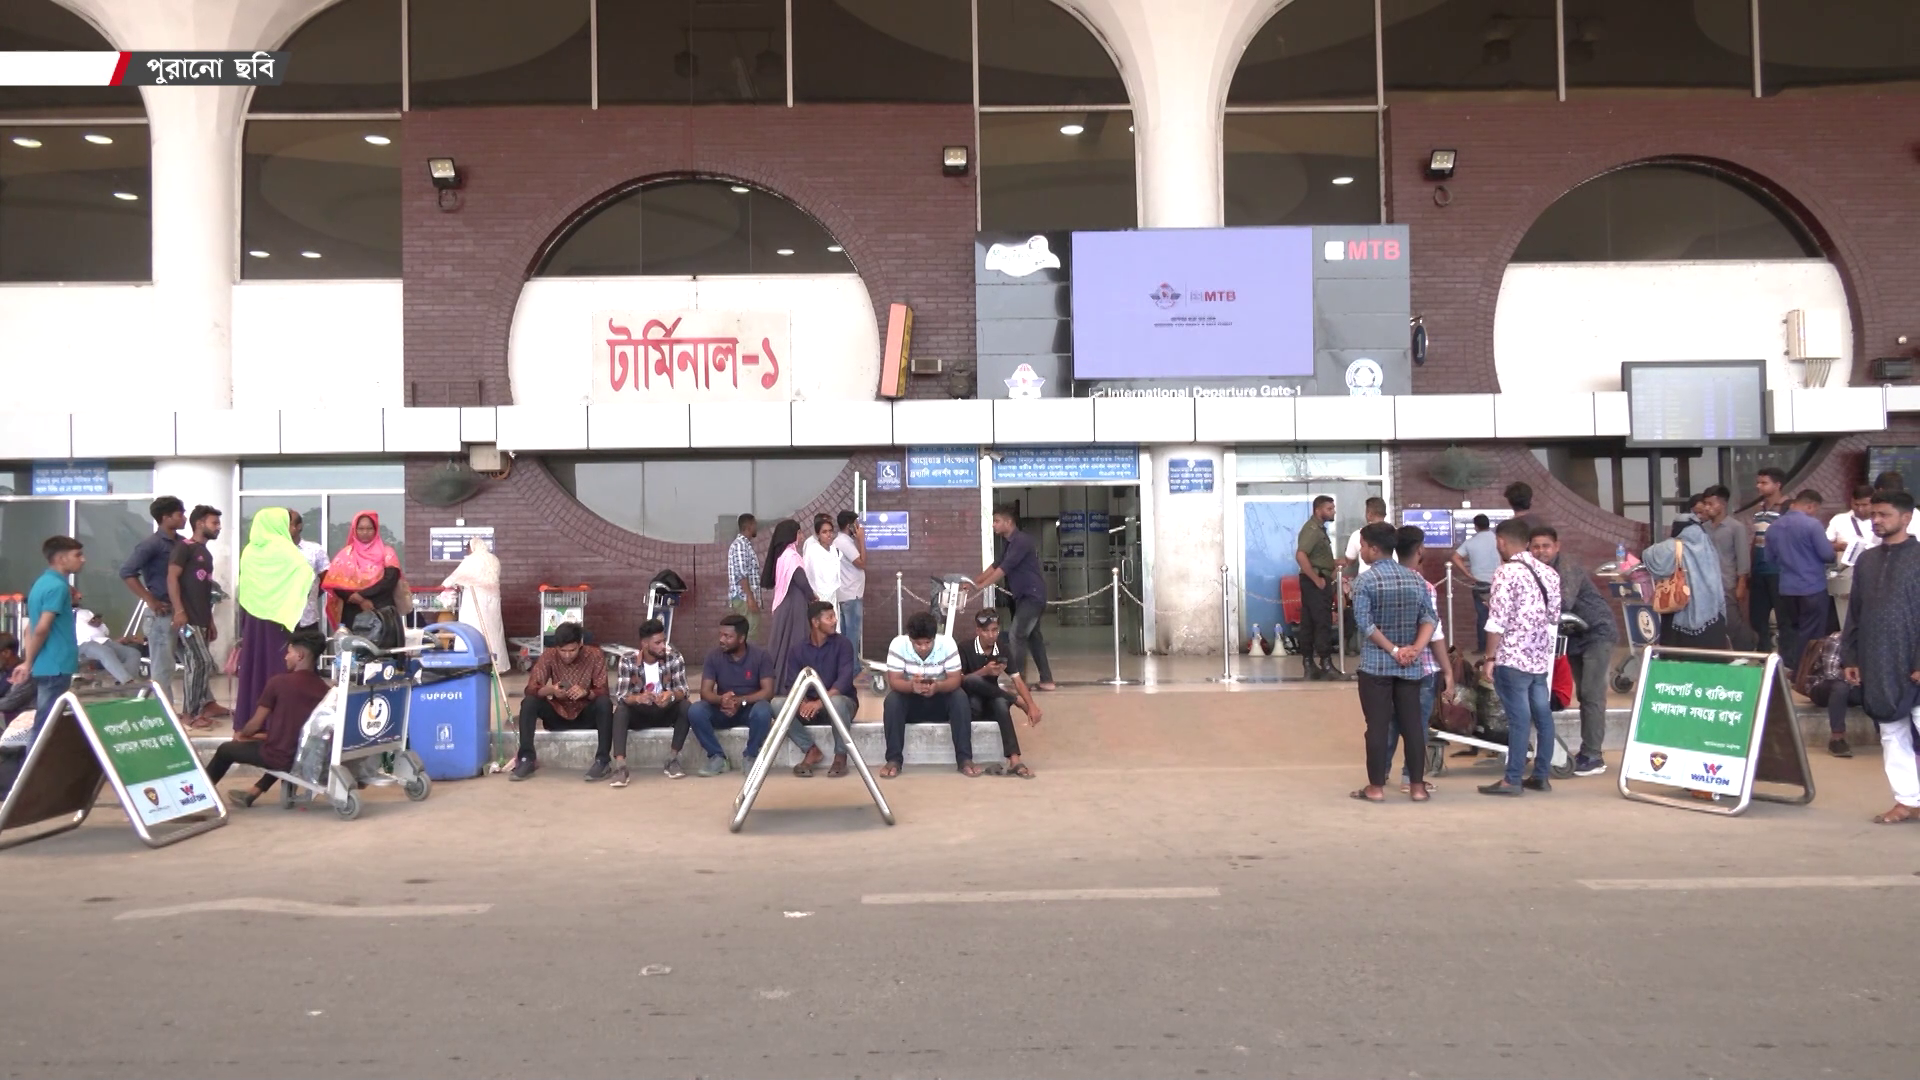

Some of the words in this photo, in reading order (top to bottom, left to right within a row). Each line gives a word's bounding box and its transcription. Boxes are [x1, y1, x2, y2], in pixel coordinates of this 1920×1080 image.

[1347, 240, 1401, 261] MTB
[1204, 291, 1236, 302] MTB
[606, 317, 779, 392] টার্মিনাল-১
[1107, 386, 1190, 398] International
[1193, 385, 1257, 398] Departure
[1654, 682, 1694, 697] পাসপোর্ট
[1694, 687, 1703, 698] ও
[1705, 685, 1745, 702] ব্যক্তিগত
[1650, 701, 1688, 718] মালামাল
[1718, 709, 1744, 727] রাখুন
[1691, 773, 1730, 786] WALTON
